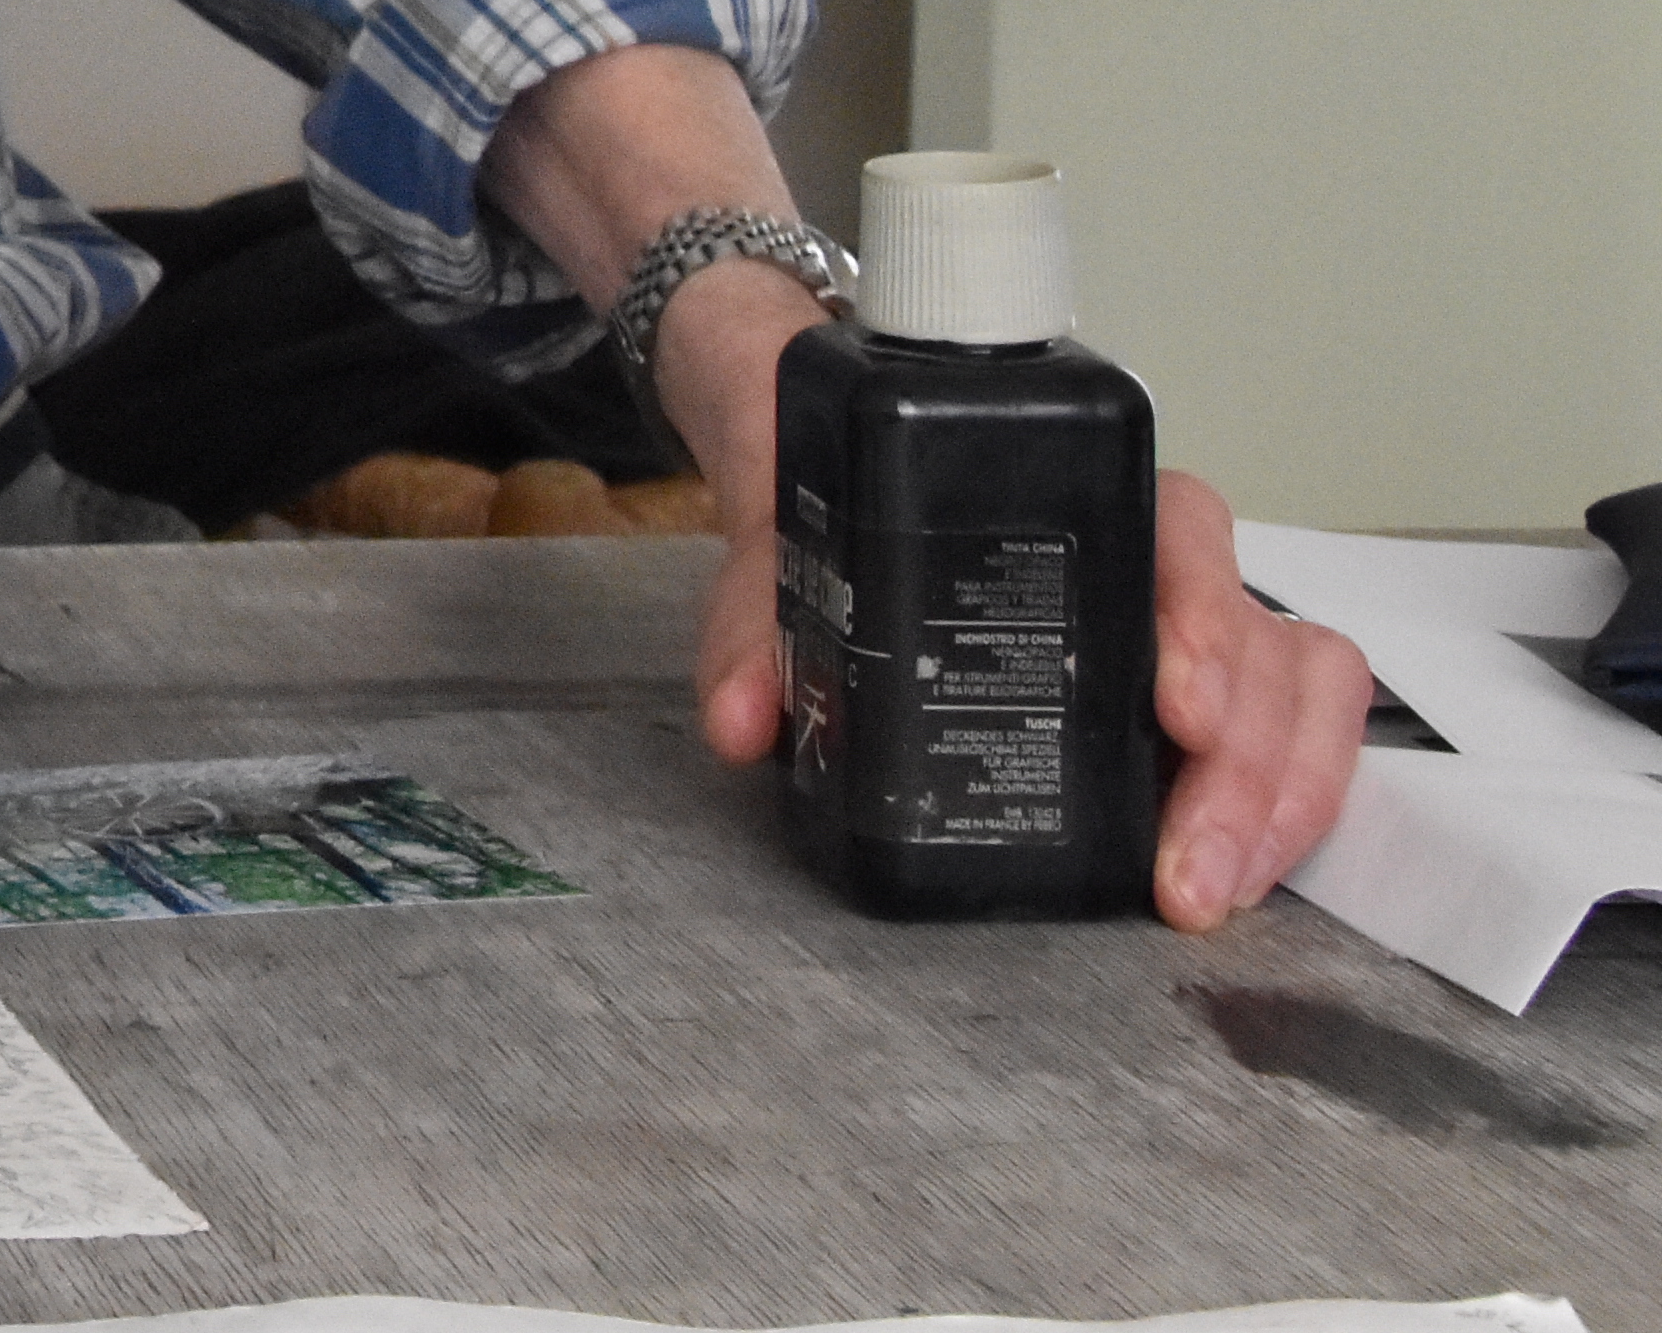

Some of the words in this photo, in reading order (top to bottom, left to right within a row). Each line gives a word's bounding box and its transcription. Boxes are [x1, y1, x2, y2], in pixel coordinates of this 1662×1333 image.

[955, 633, 1016, 645] INCHIOSTRO
[1031, 634, 1064, 645] CHINA
[1025, 717, 1062, 730] TUSCHE
[945, 818, 971, 830] MADE
[973, 818, 984, 830] IN
[985, 818, 1019, 831] FRANCE
